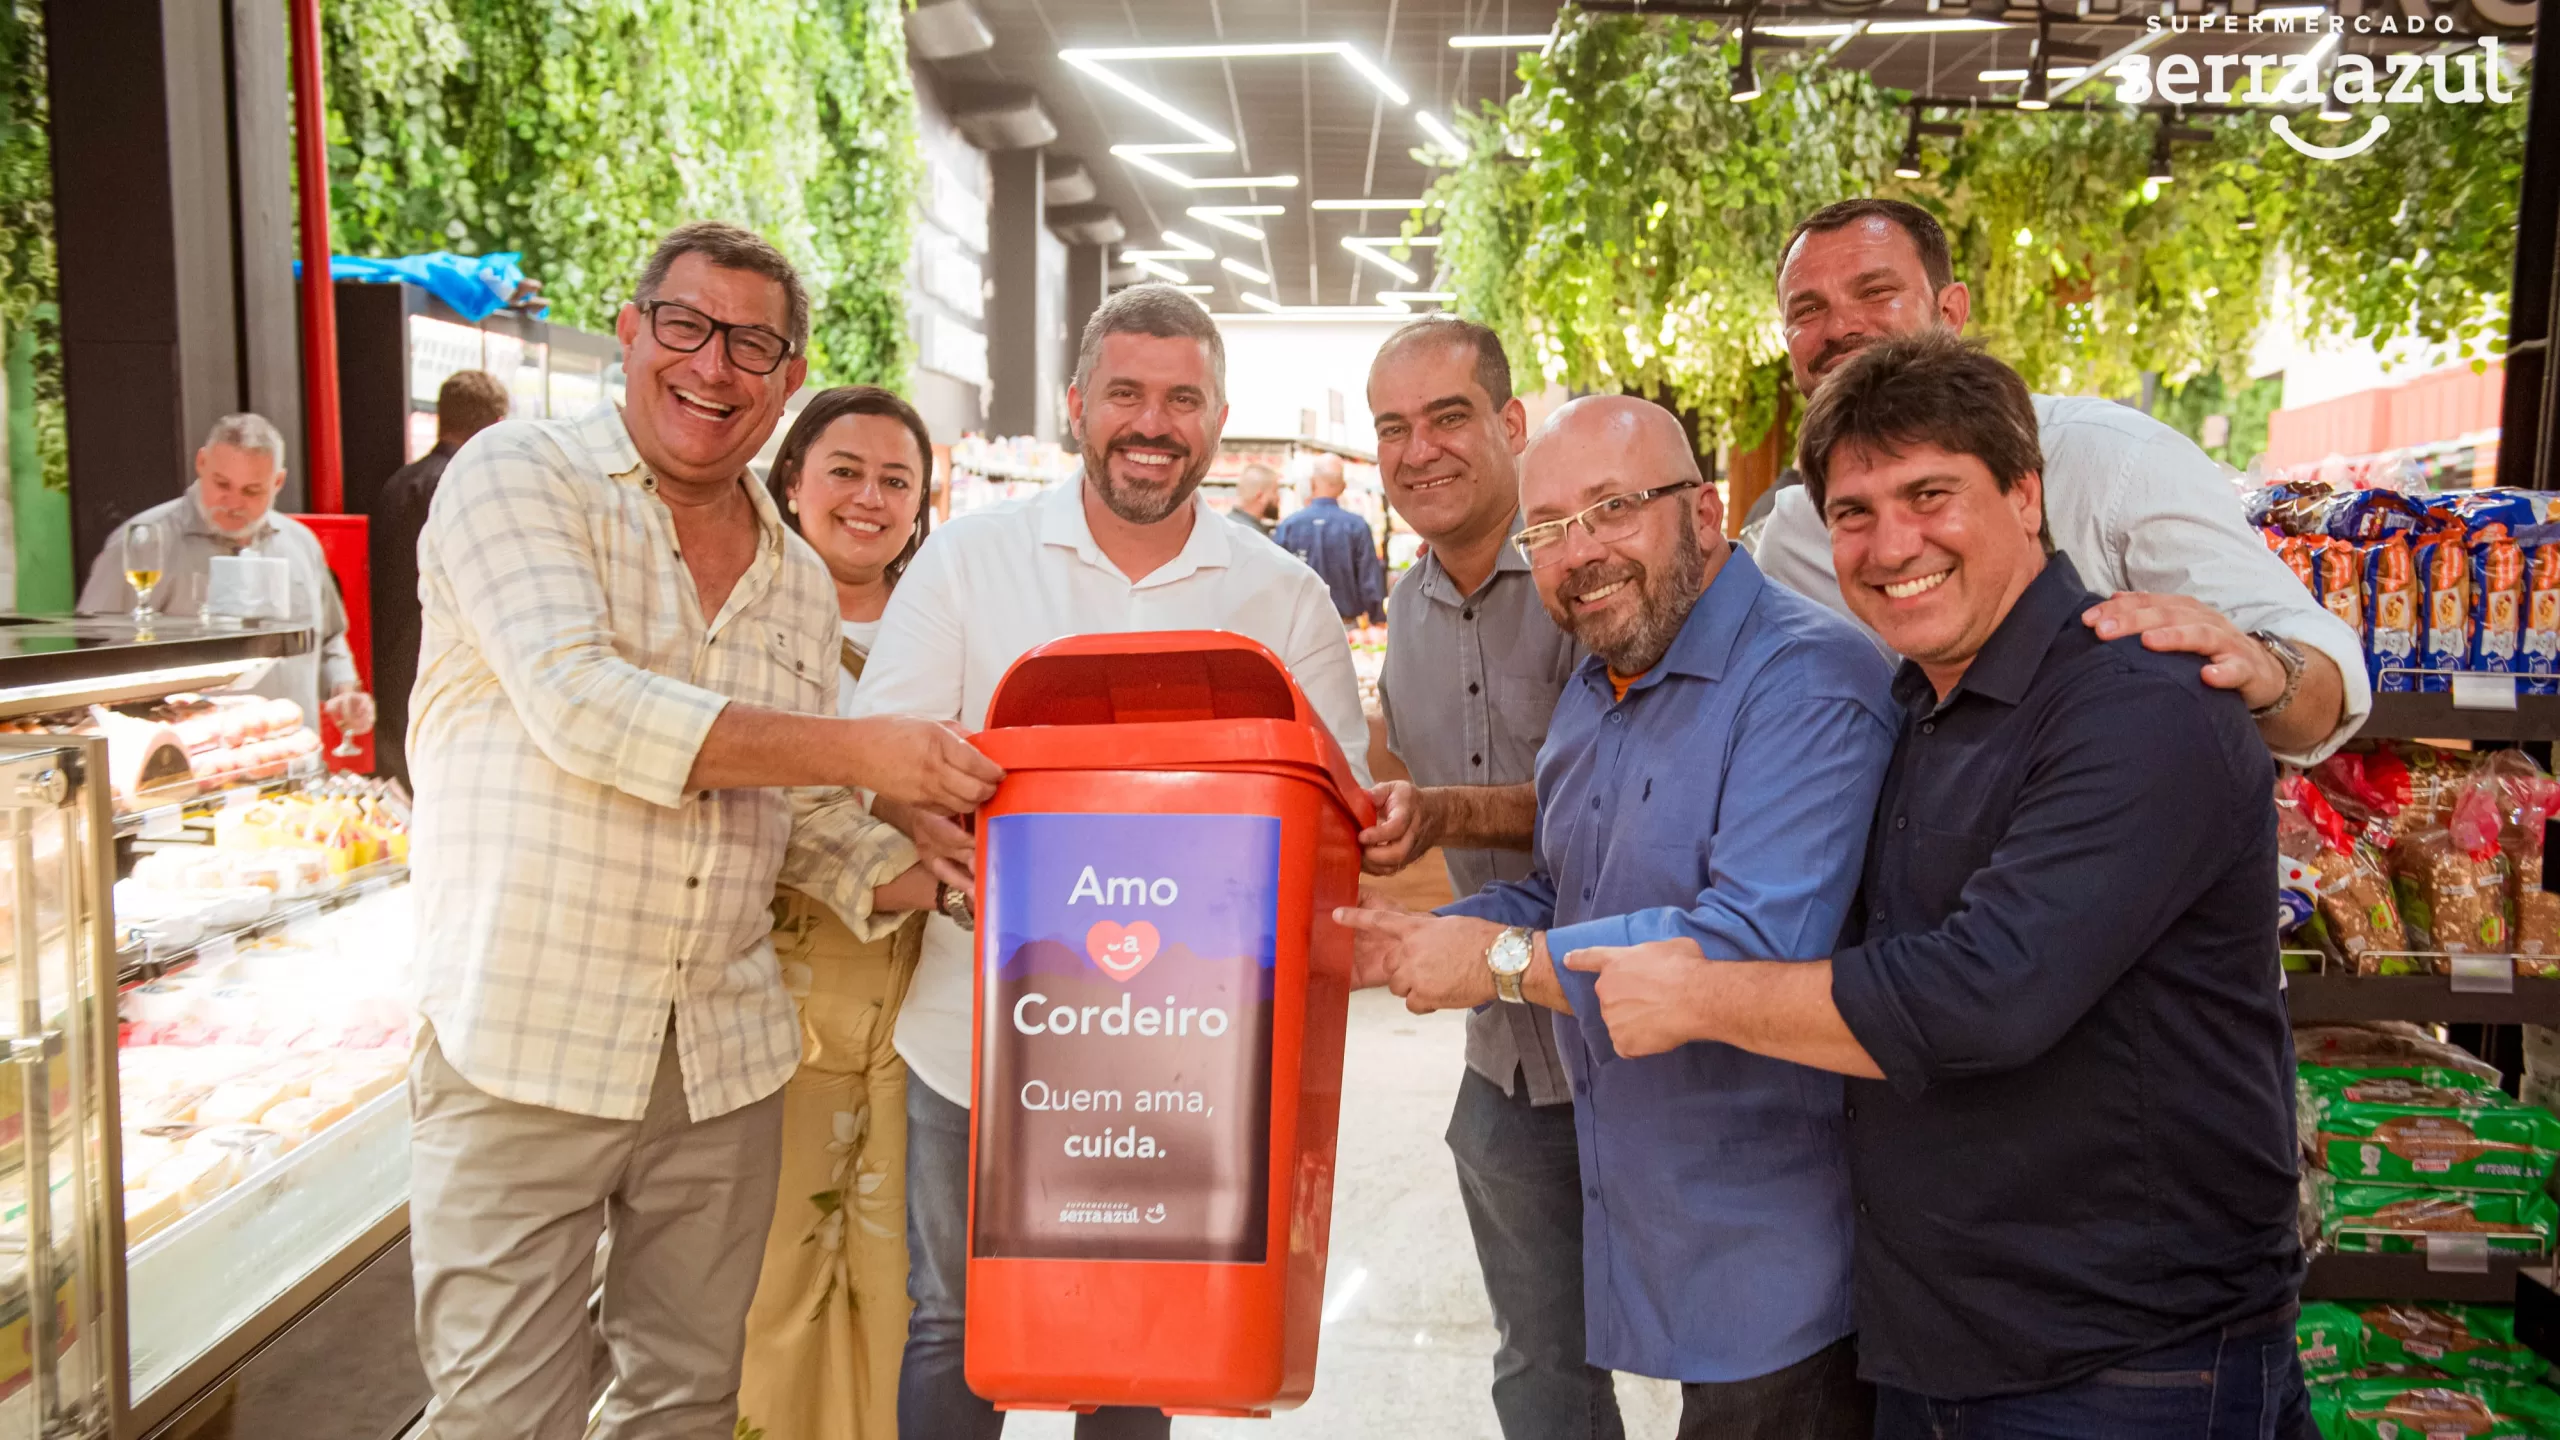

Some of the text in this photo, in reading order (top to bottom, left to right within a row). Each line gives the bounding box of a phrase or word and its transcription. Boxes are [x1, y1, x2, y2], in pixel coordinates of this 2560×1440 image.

[1067, 865, 1179, 906] Amo
[1012, 992, 1229, 1038] Cordeiro
[1020, 1079, 1215, 1118] Quem ama,
[1063, 1126, 1167, 1159] cuida.
